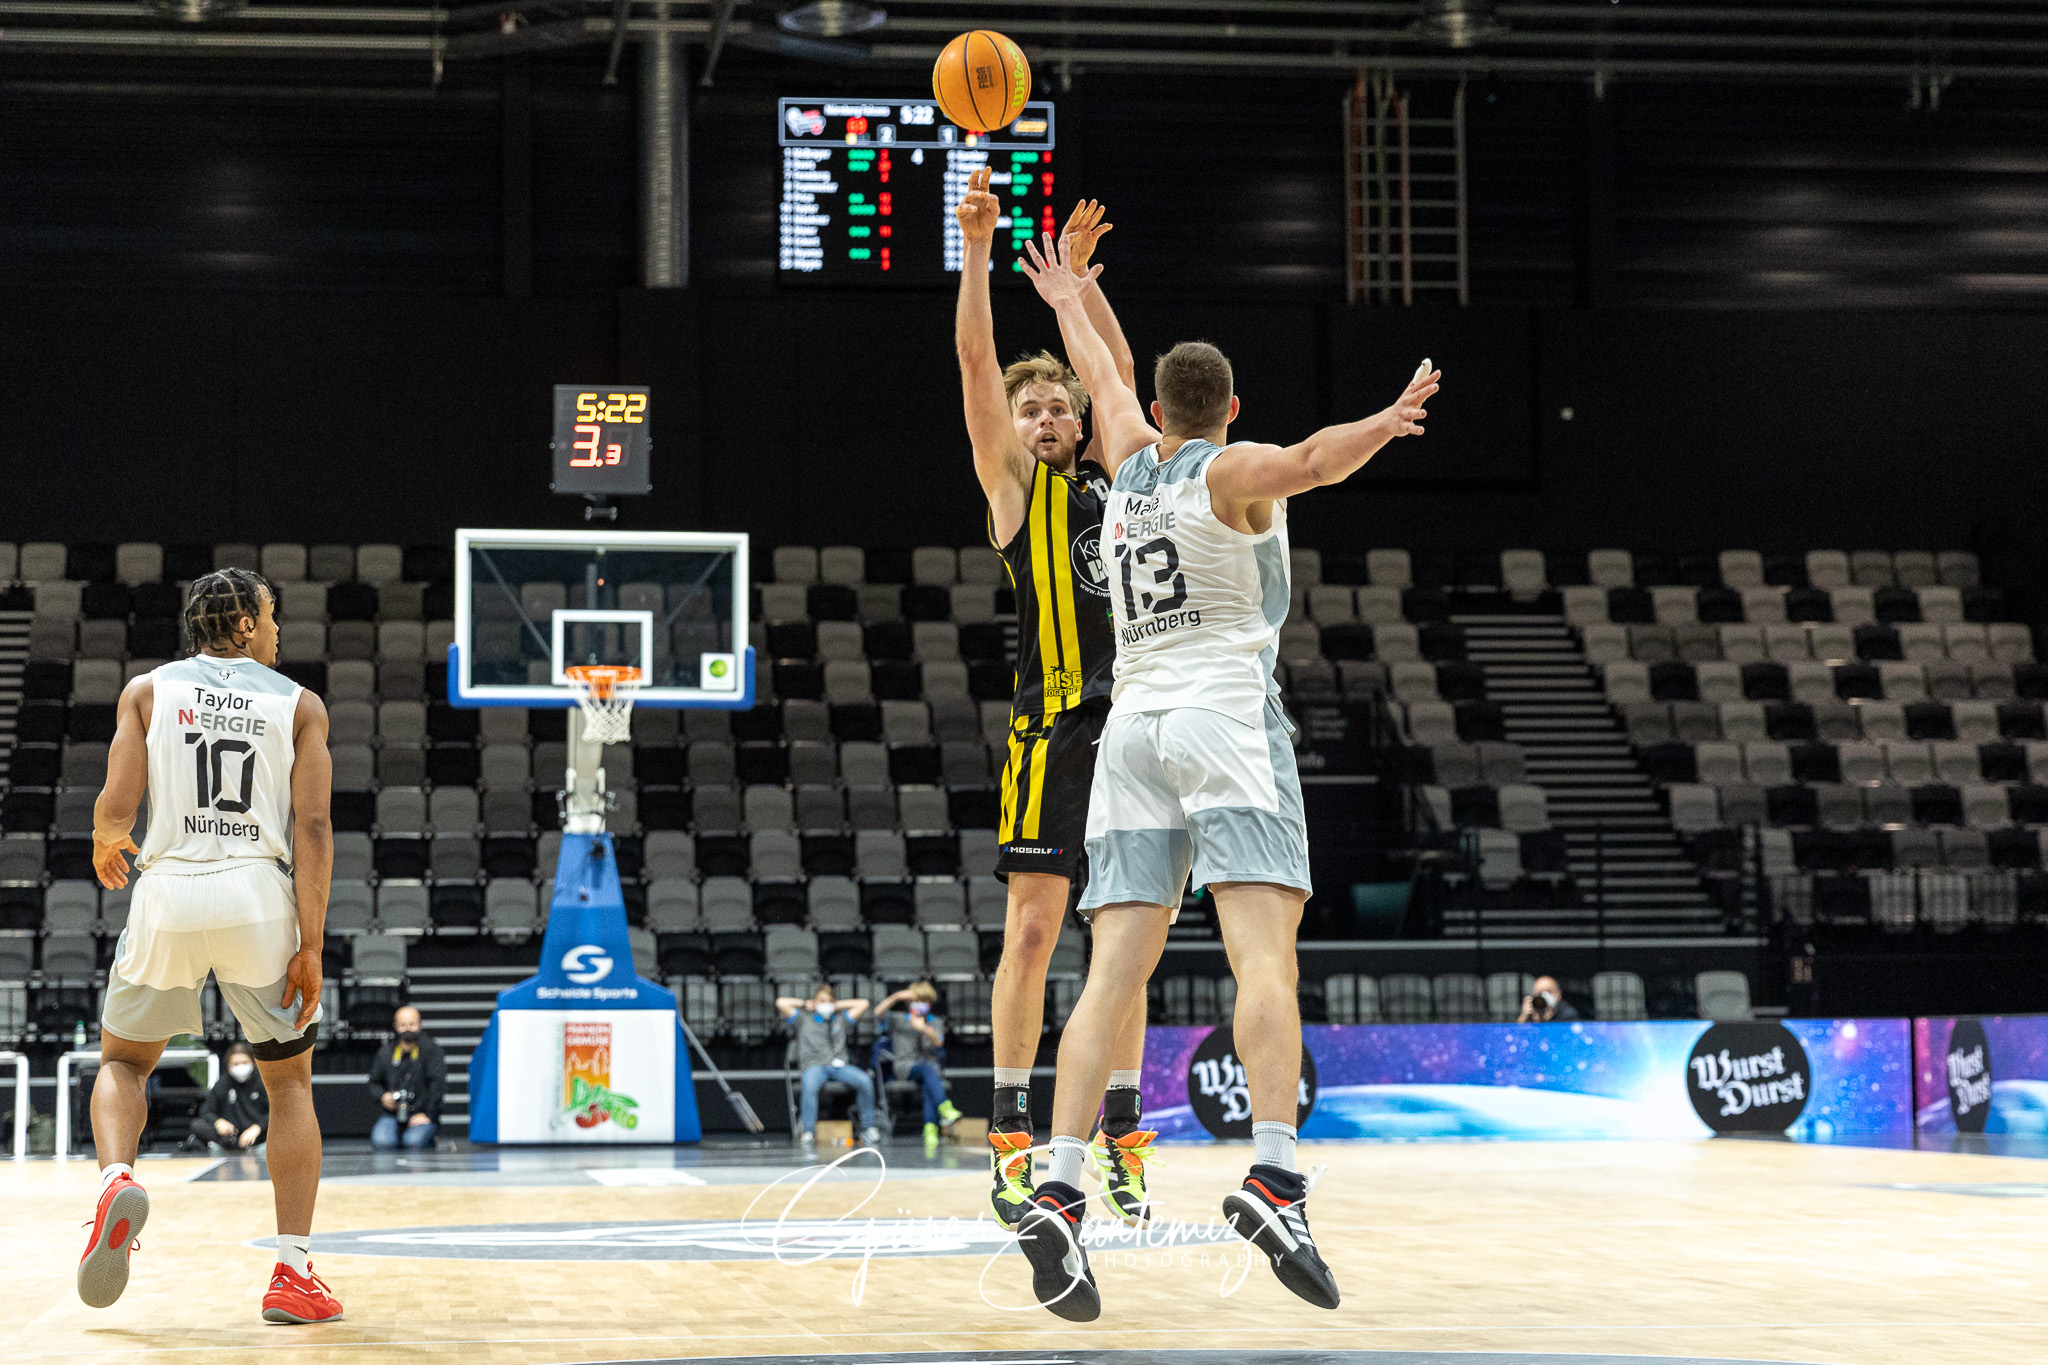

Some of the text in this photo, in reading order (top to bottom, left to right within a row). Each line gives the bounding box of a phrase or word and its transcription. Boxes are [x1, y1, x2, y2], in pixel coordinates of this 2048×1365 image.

[975, 66, 989, 89] FIBA
[576, 392, 648, 423] 5:22
[568, 424, 622, 468] 3.3
[1114, 536, 1188, 621] 13
[1121, 609, 1201, 646] Nürnberg
[1043, 670, 1082, 688] RISE
[195, 687, 253, 711] Taylor
[184, 732, 256, 815] 10
[1010, 846, 1053, 855] MOSOLF
[592, 986, 639, 1002] Sports
[1690, 1046, 1787, 1091] Wurst
[1717, 1071, 1806, 1117] Durst
